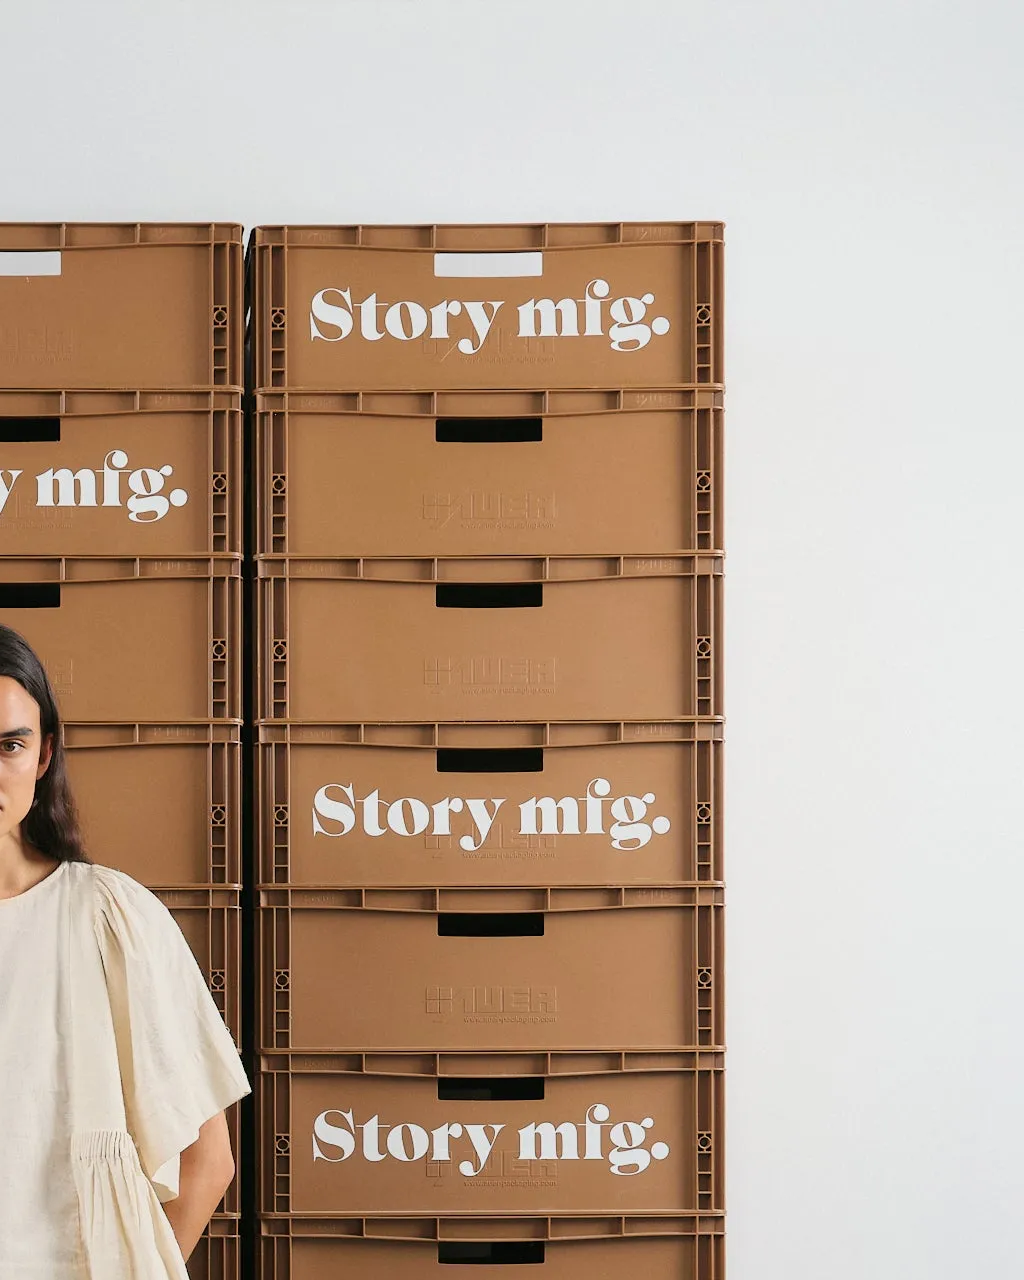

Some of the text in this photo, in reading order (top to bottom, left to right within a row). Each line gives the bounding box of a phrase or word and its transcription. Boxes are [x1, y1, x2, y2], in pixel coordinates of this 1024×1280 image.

[309, 278, 671, 355] Story mfg.
[35, 449, 188, 523] mfg.
[311, 777, 671, 852] Story mfg.
[311, 1103, 670, 1177] Story mfg.
